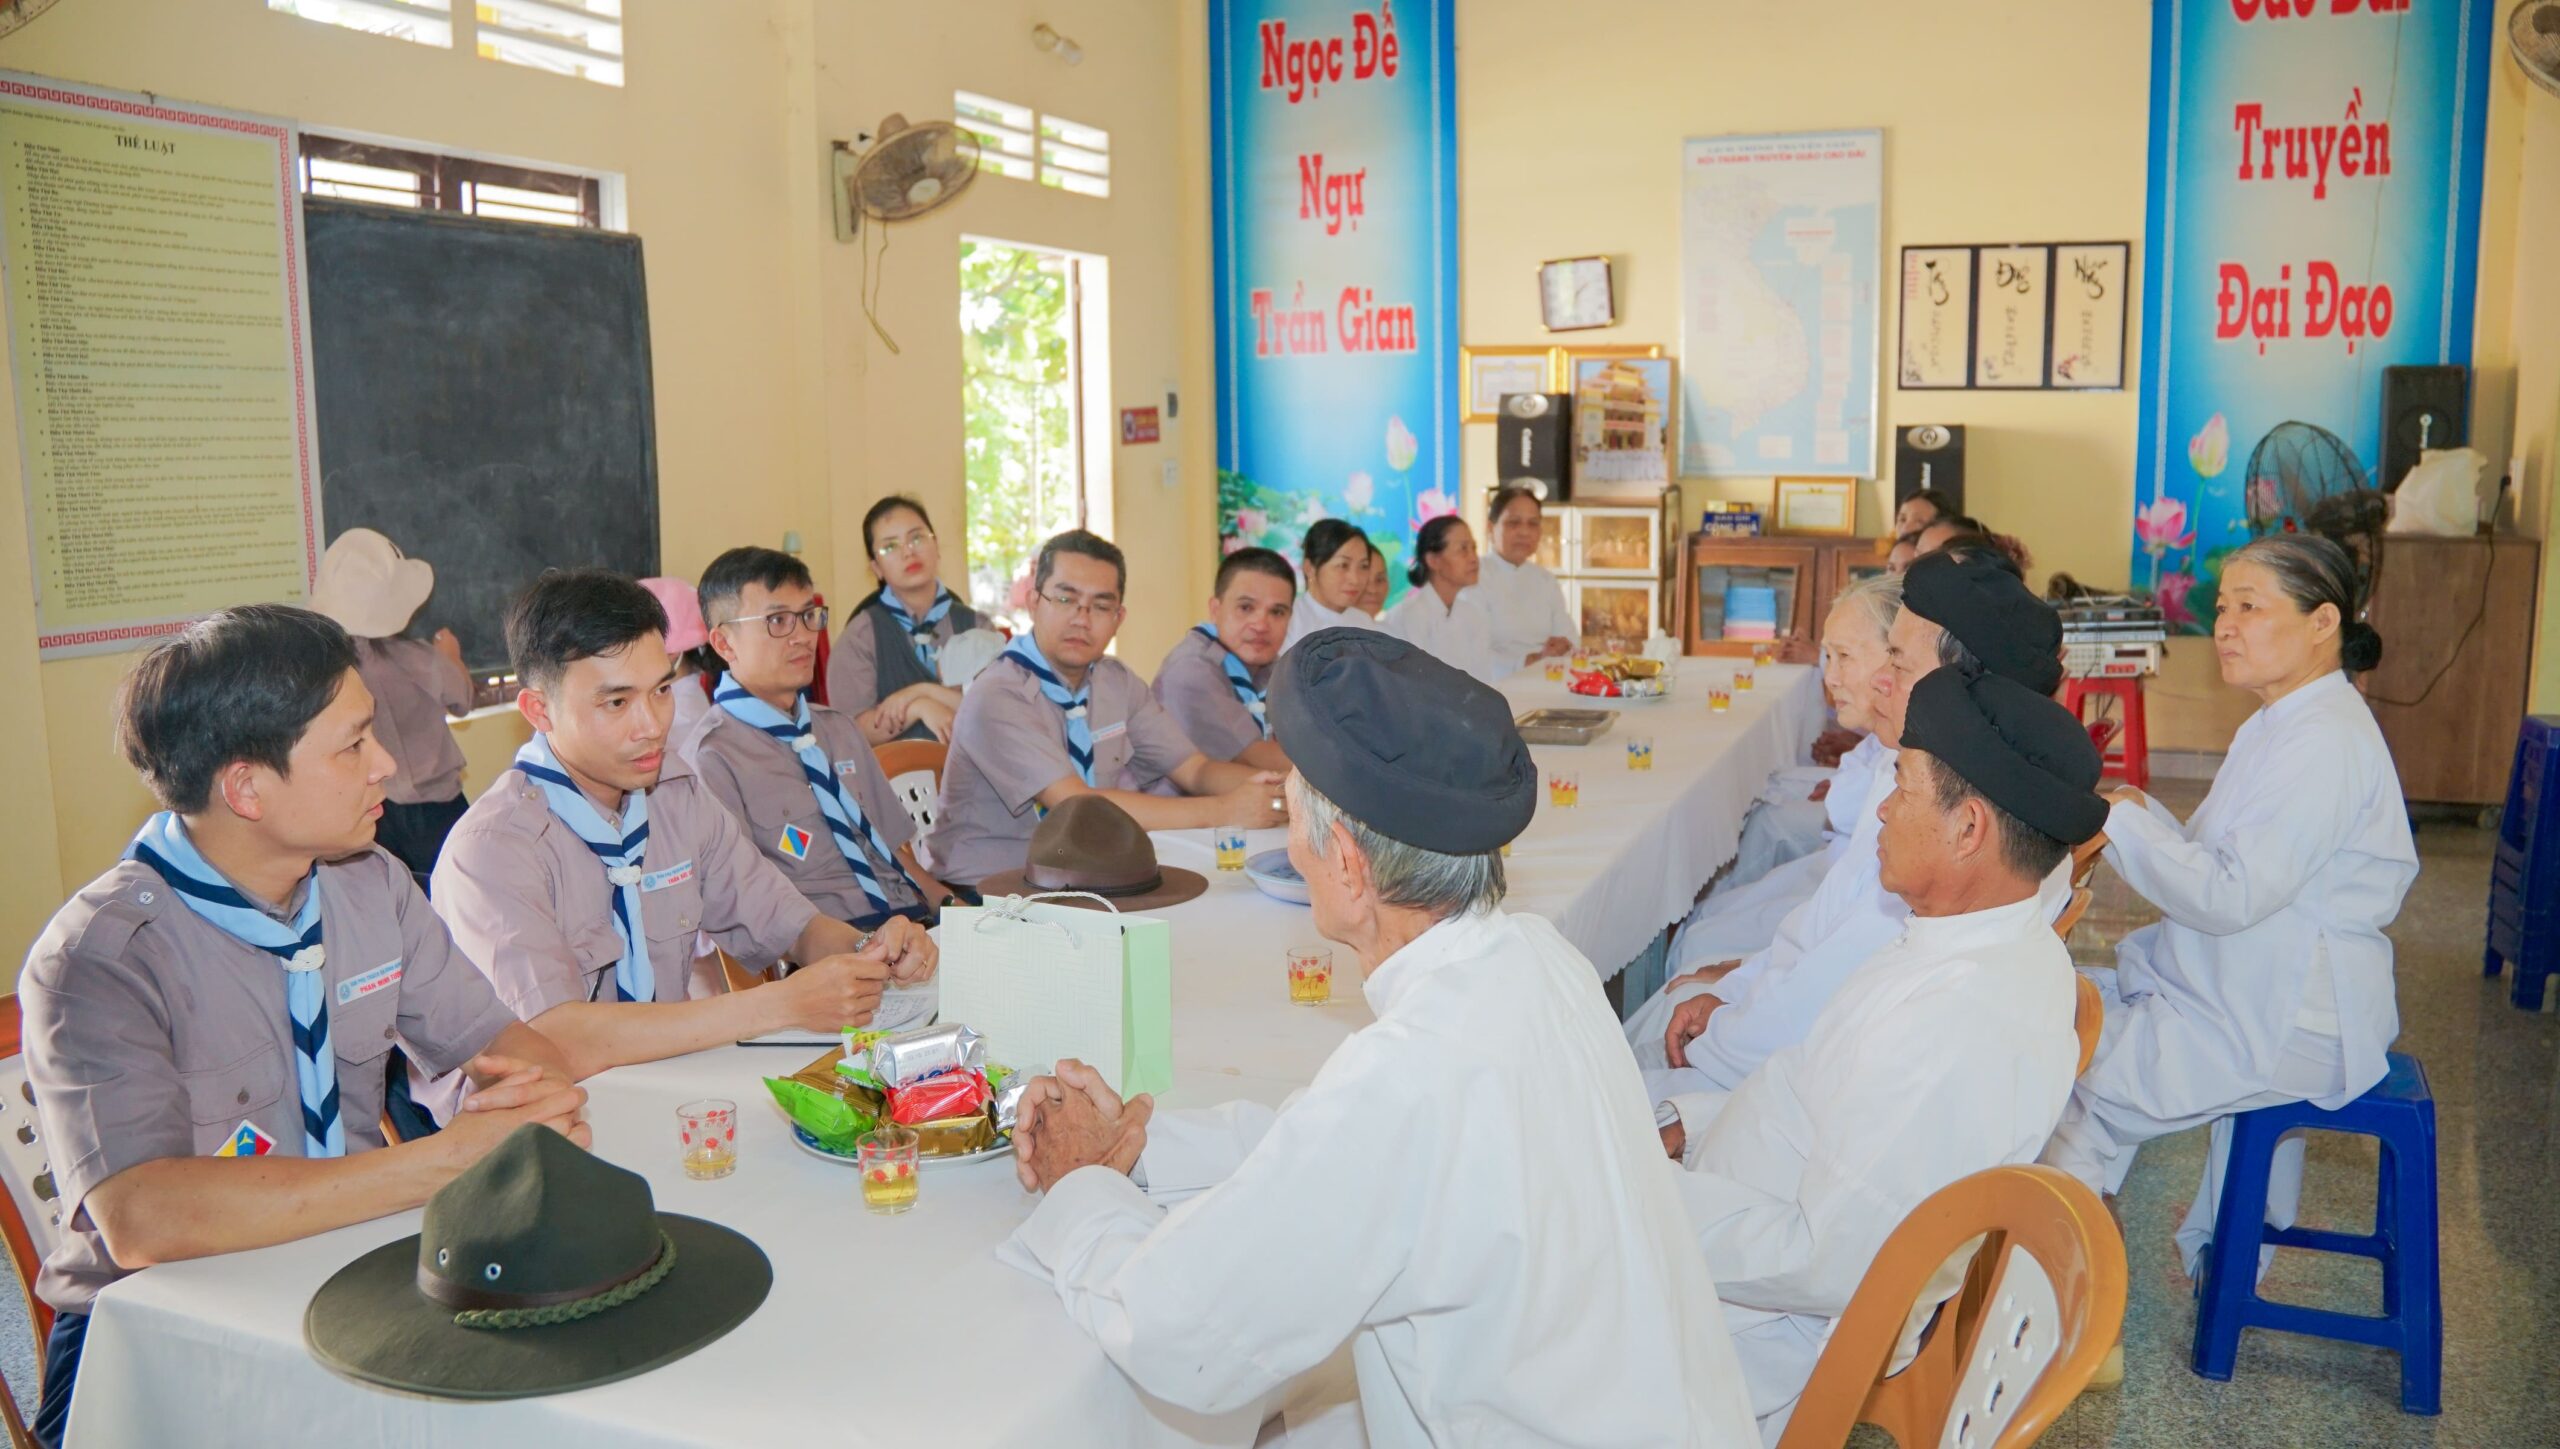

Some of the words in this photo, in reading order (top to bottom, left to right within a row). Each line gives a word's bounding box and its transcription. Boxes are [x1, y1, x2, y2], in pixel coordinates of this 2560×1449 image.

[1260, 20, 1343, 104] Ngọc
[1352, 1, 1399, 80] Đế
[2234, 86, 2391, 200] Truyền
[1298, 153, 1366, 235] Ngự
[1251, 280, 1327, 356] Trần
[1337, 286, 1416, 353] Gian
[2216, 263, 2291, 355] Đại
[2304, 260, 2392, 354] Đạo
